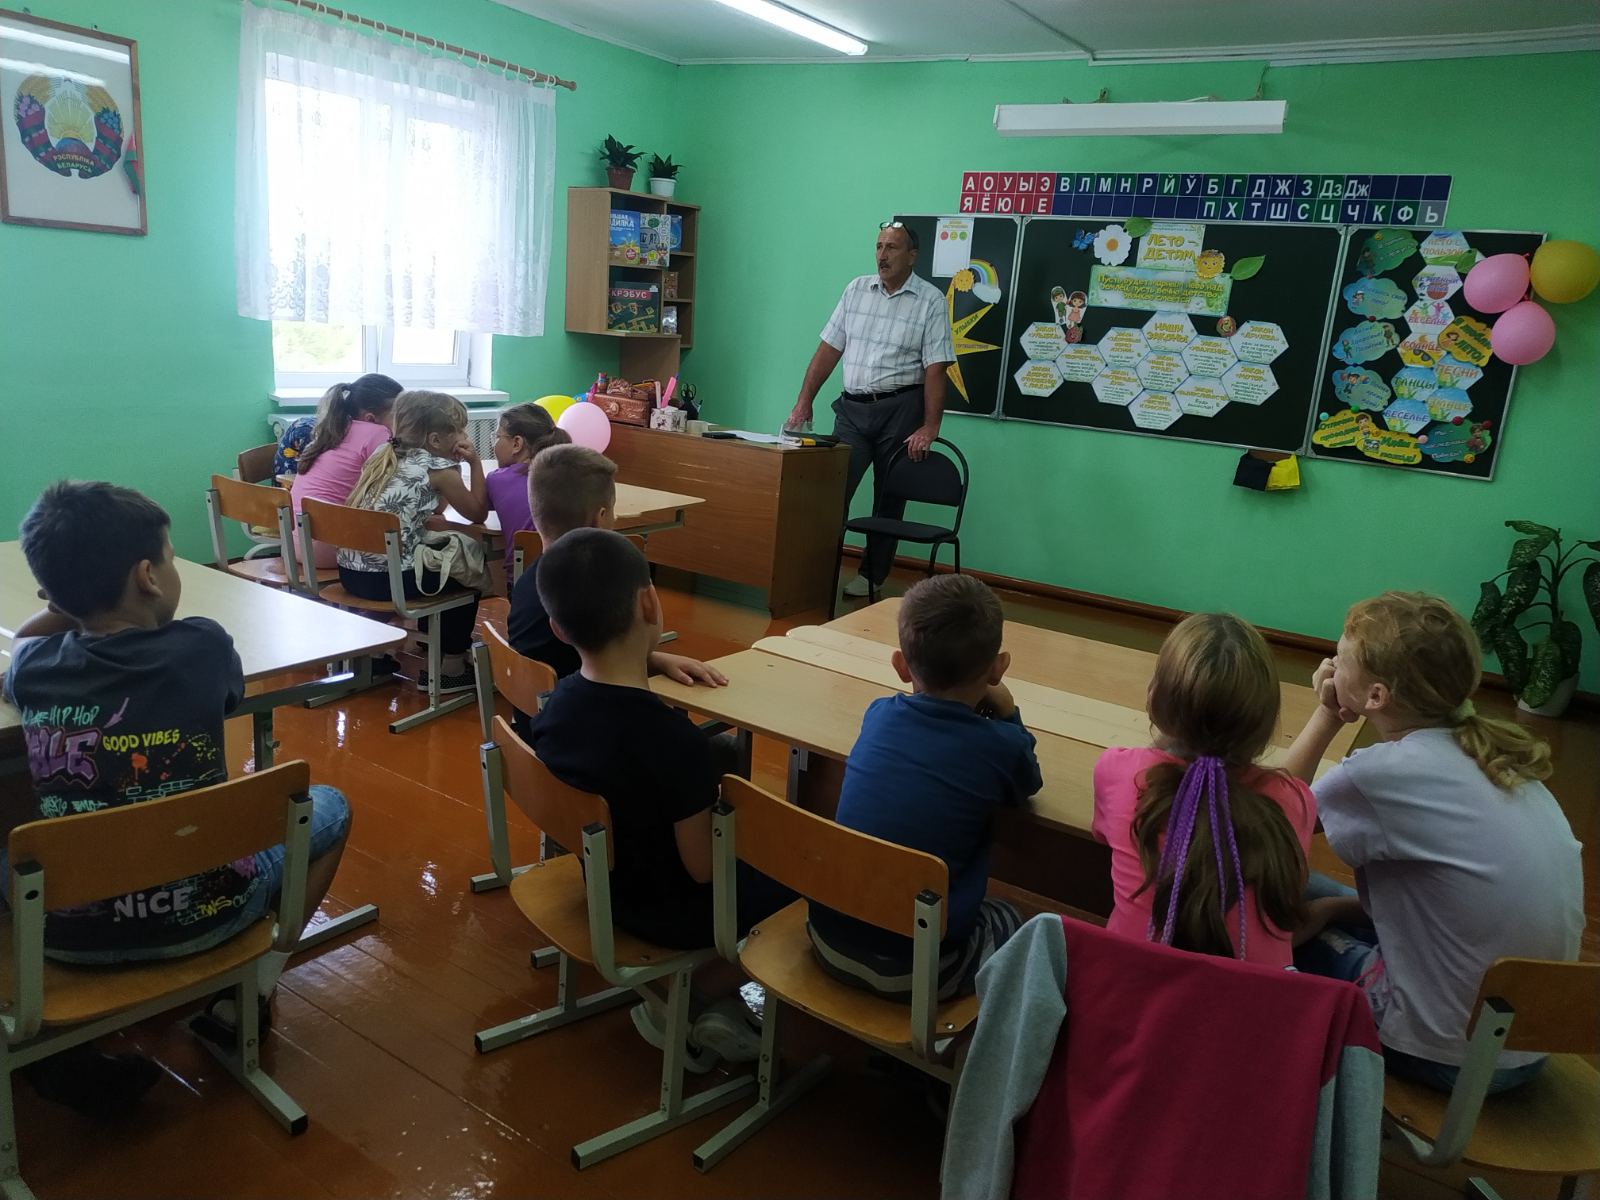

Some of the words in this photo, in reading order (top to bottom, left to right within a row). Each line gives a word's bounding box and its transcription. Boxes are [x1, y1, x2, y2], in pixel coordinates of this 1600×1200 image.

[965, 177, 975, 190] А
[984, 176, 994, 190] О
[1003, 177, 1013, 191] У
[1019, 177, 1033, 191] Ы
[1040, 177, 1050, 192] Э
[1060, 177, 1070, 191] В
[1078, 177, 1090, 192] Л
[1099, 177, 1112, 192] М
[1121, 178, 1131, 193] Н
[1143, 178, 1153, 193] Р
[1163, 175, 1175, 193] Й
[1185, 175, 1196, 193] Ў
[1207, 179, 1219, 194] Б
[1231, 179, 1242, 194] Г
[1252, 179, 1265, 198] Д
[1275, 179, 1292, 195] Ж
[1302, 179, 1313, 196] З
[1319, 180, 1342, 199] Дз
[1344, 180, 1369, 199] Дж
[962, 197, 972, 211] Я
[981, 193, 991, 211] Ё
[998, 197, 1011, 212] Ю
[1037, 198, 1047, 212] Е
[1203, 202, 1216, 216] П
[1225, 202, 1237, 217] Х
[1250, 203, 1261, 218] Т
[1270, 203, 1288, 219] Ш
[1298, 203, 1310, 219] С
[1321, 204, 1335, 223] Ц
[1348, 204, 1359, 221] Ч
[1373, 205, 1386, 221] К
[1397, 205, 1414, 222] Ф
[1425, 206, 1438, 223] Ь
[1147, 233, 1185, 247] ЛЕТО
[1143, 247, 1197, 262] ДЕТЯМ
[1436, 364, 1478, 378] ПЕСНИ
[1395, 377, 1435, 390] ТАНЦЫ
[1384, 409, 1429, 423] ВЕСЕЛЬЕ
[102, 734, 139, 753] GOOD
[141, 728, 181, 748] VIBES
